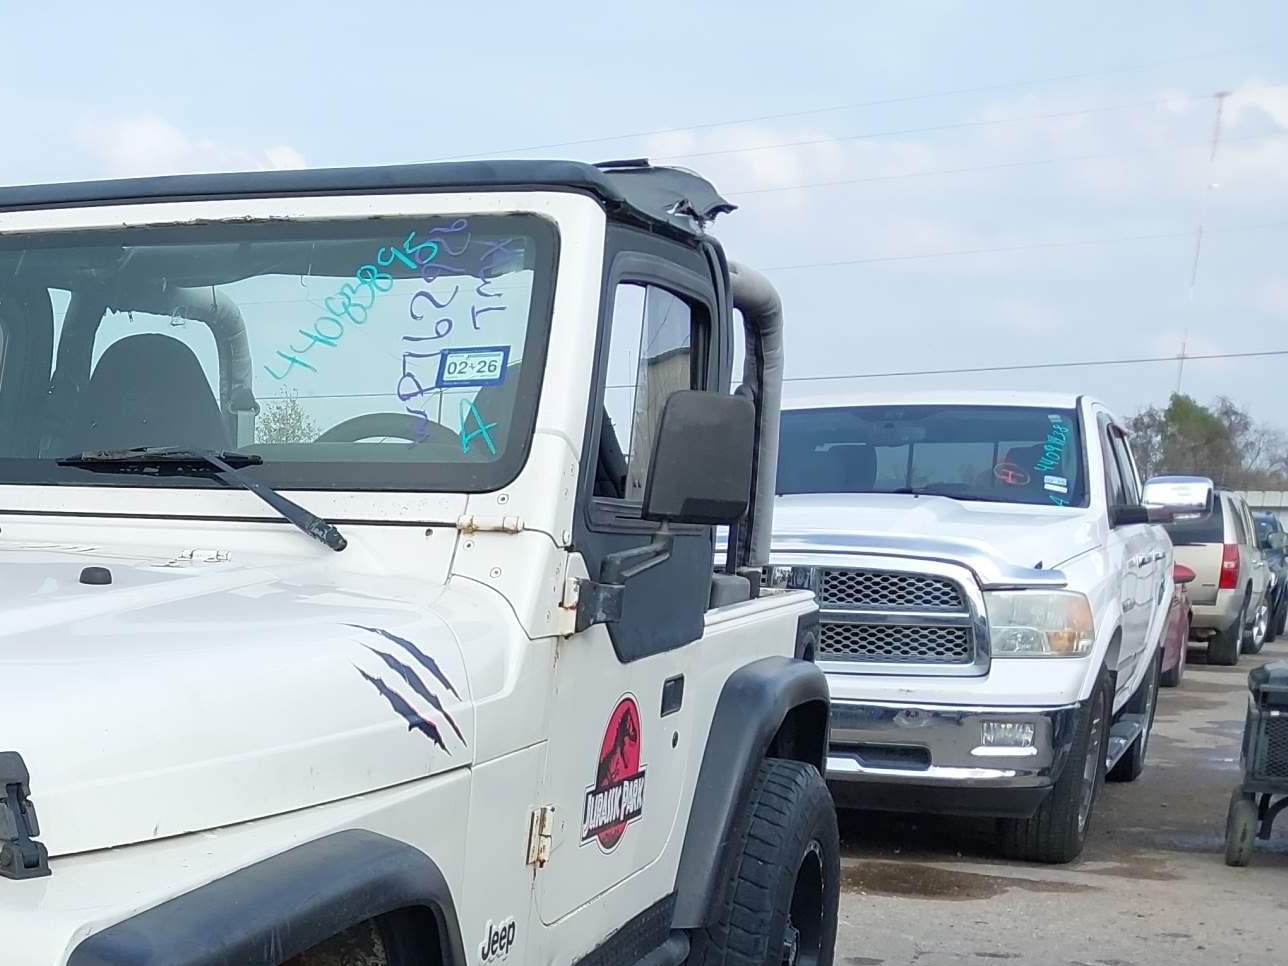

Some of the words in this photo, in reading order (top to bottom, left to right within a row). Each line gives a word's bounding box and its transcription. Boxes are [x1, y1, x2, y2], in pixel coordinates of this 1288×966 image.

[263, 231, 439, 380] 44083895
[459, 398, 498, 455] A
[619, 775, 646, 822] PARK
[481, 921, 516, 961] Jeep
